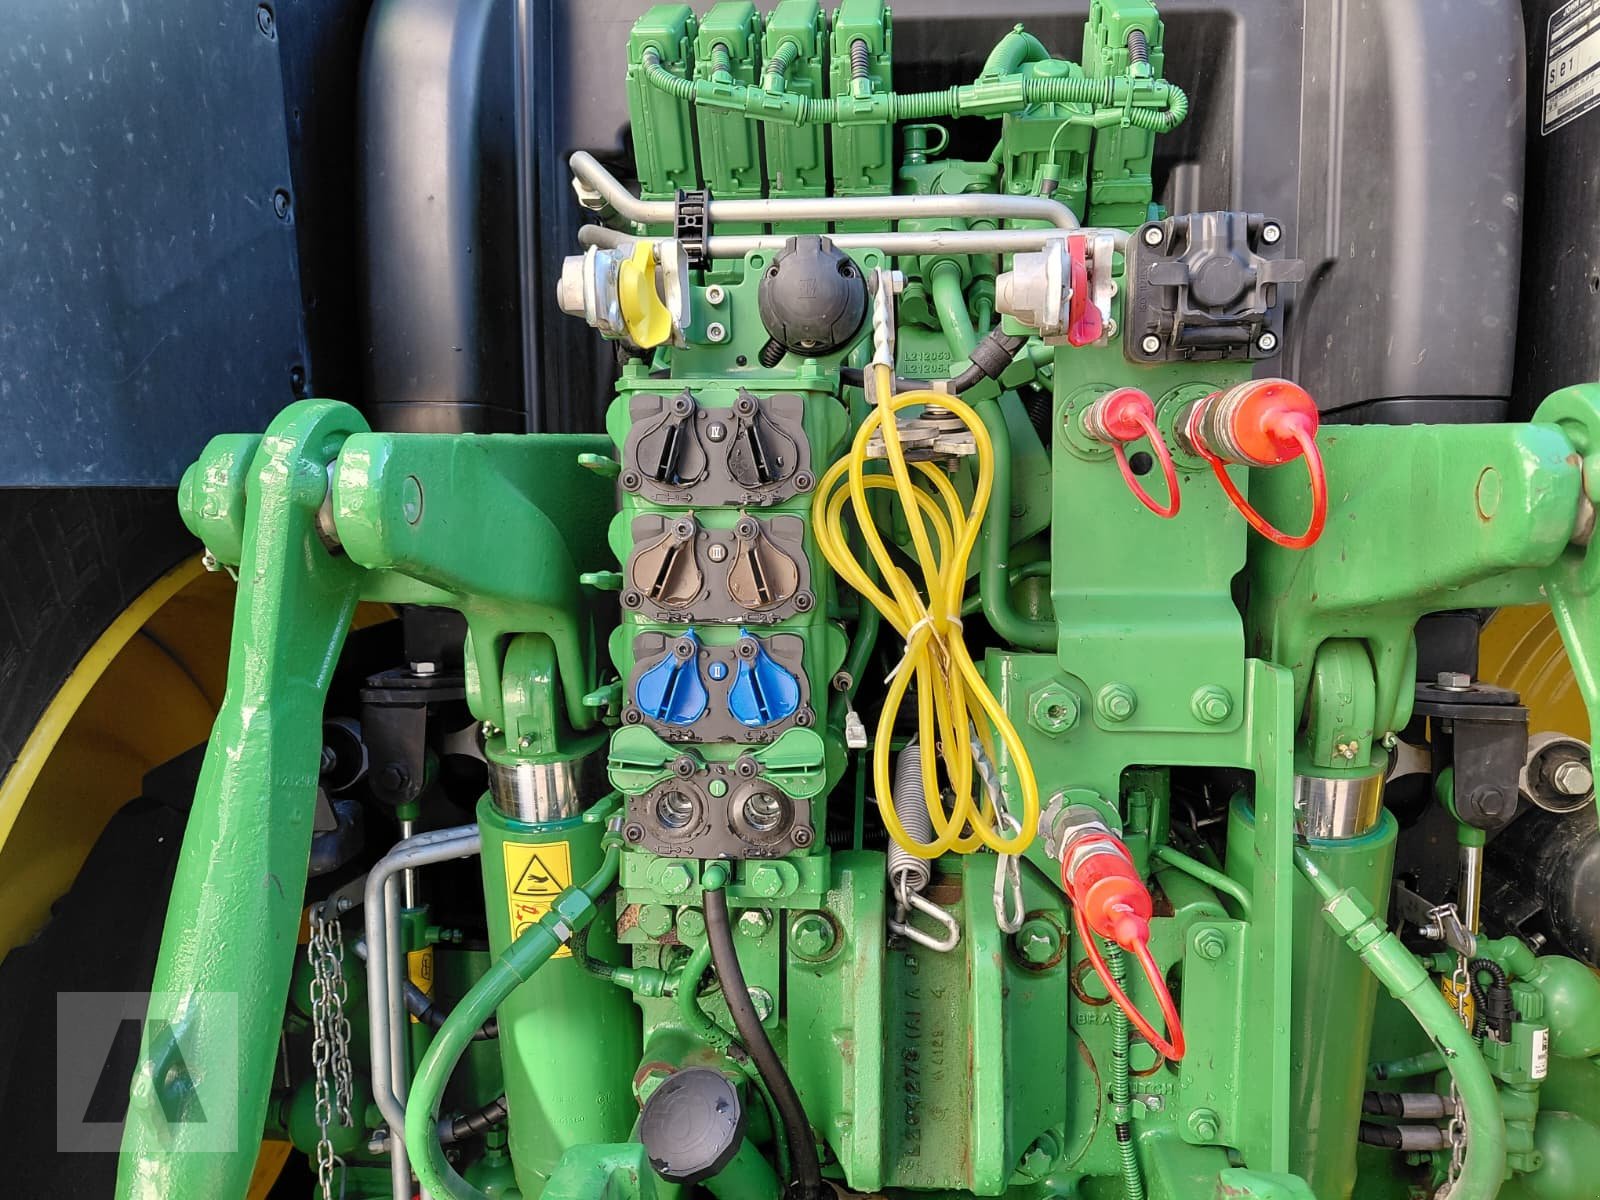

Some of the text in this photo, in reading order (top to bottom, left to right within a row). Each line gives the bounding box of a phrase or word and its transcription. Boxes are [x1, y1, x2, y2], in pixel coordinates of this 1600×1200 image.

[711, 426, 720, 438] IV
[711, 547, 722, 559] III
[714, 667, 721, 677] II
